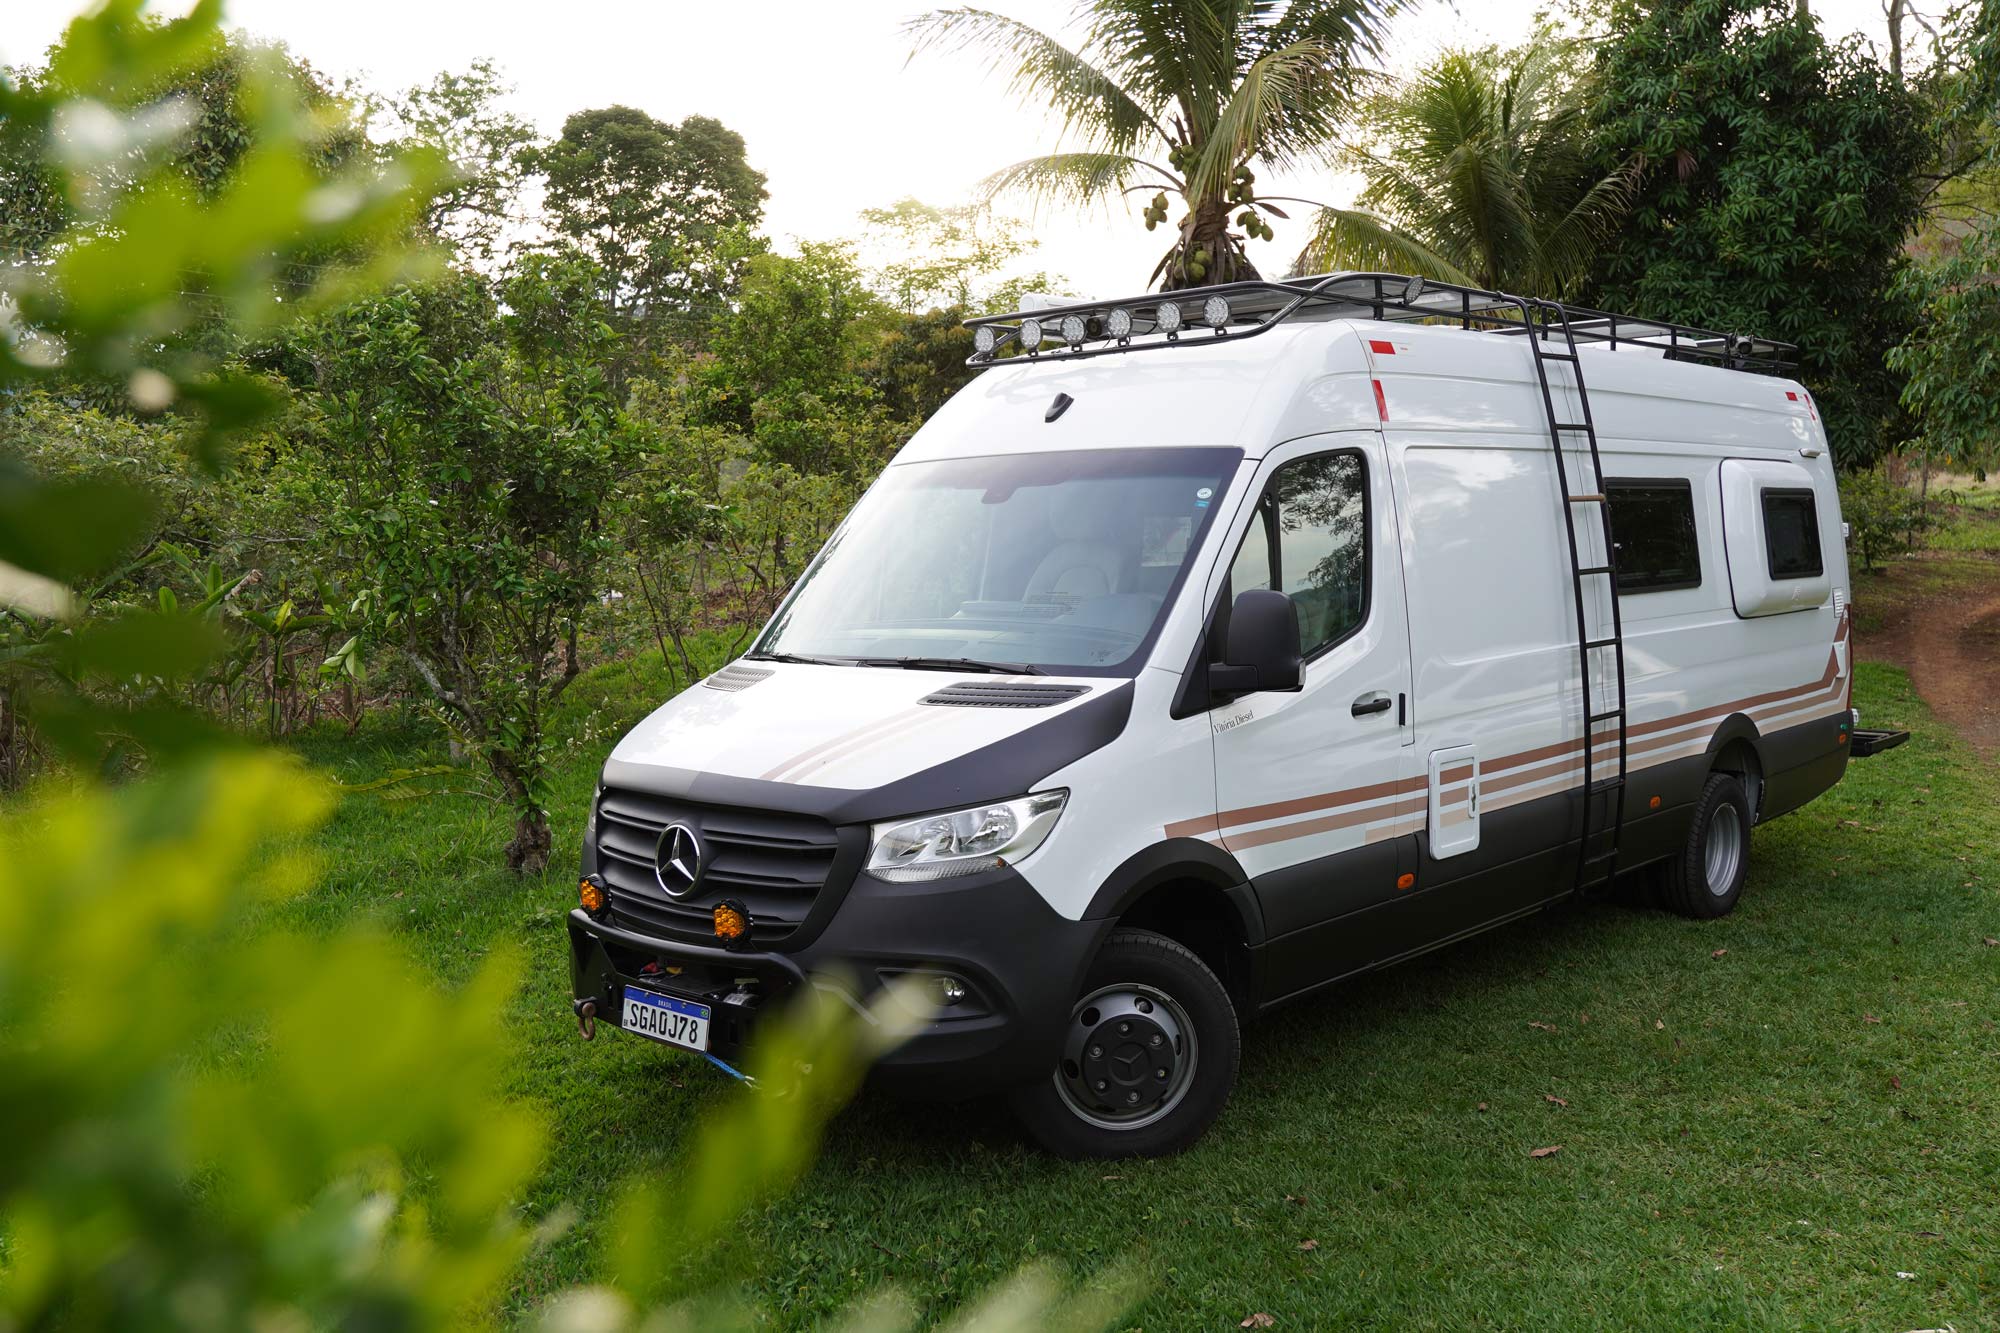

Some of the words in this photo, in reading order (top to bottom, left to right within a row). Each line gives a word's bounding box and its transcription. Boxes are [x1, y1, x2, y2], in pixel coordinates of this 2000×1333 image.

[1213, 717, 1236, 734] Vitória
[1235, 709, 1254, 726] Diesel
[657, 999, 672, 1009] BRASIL
